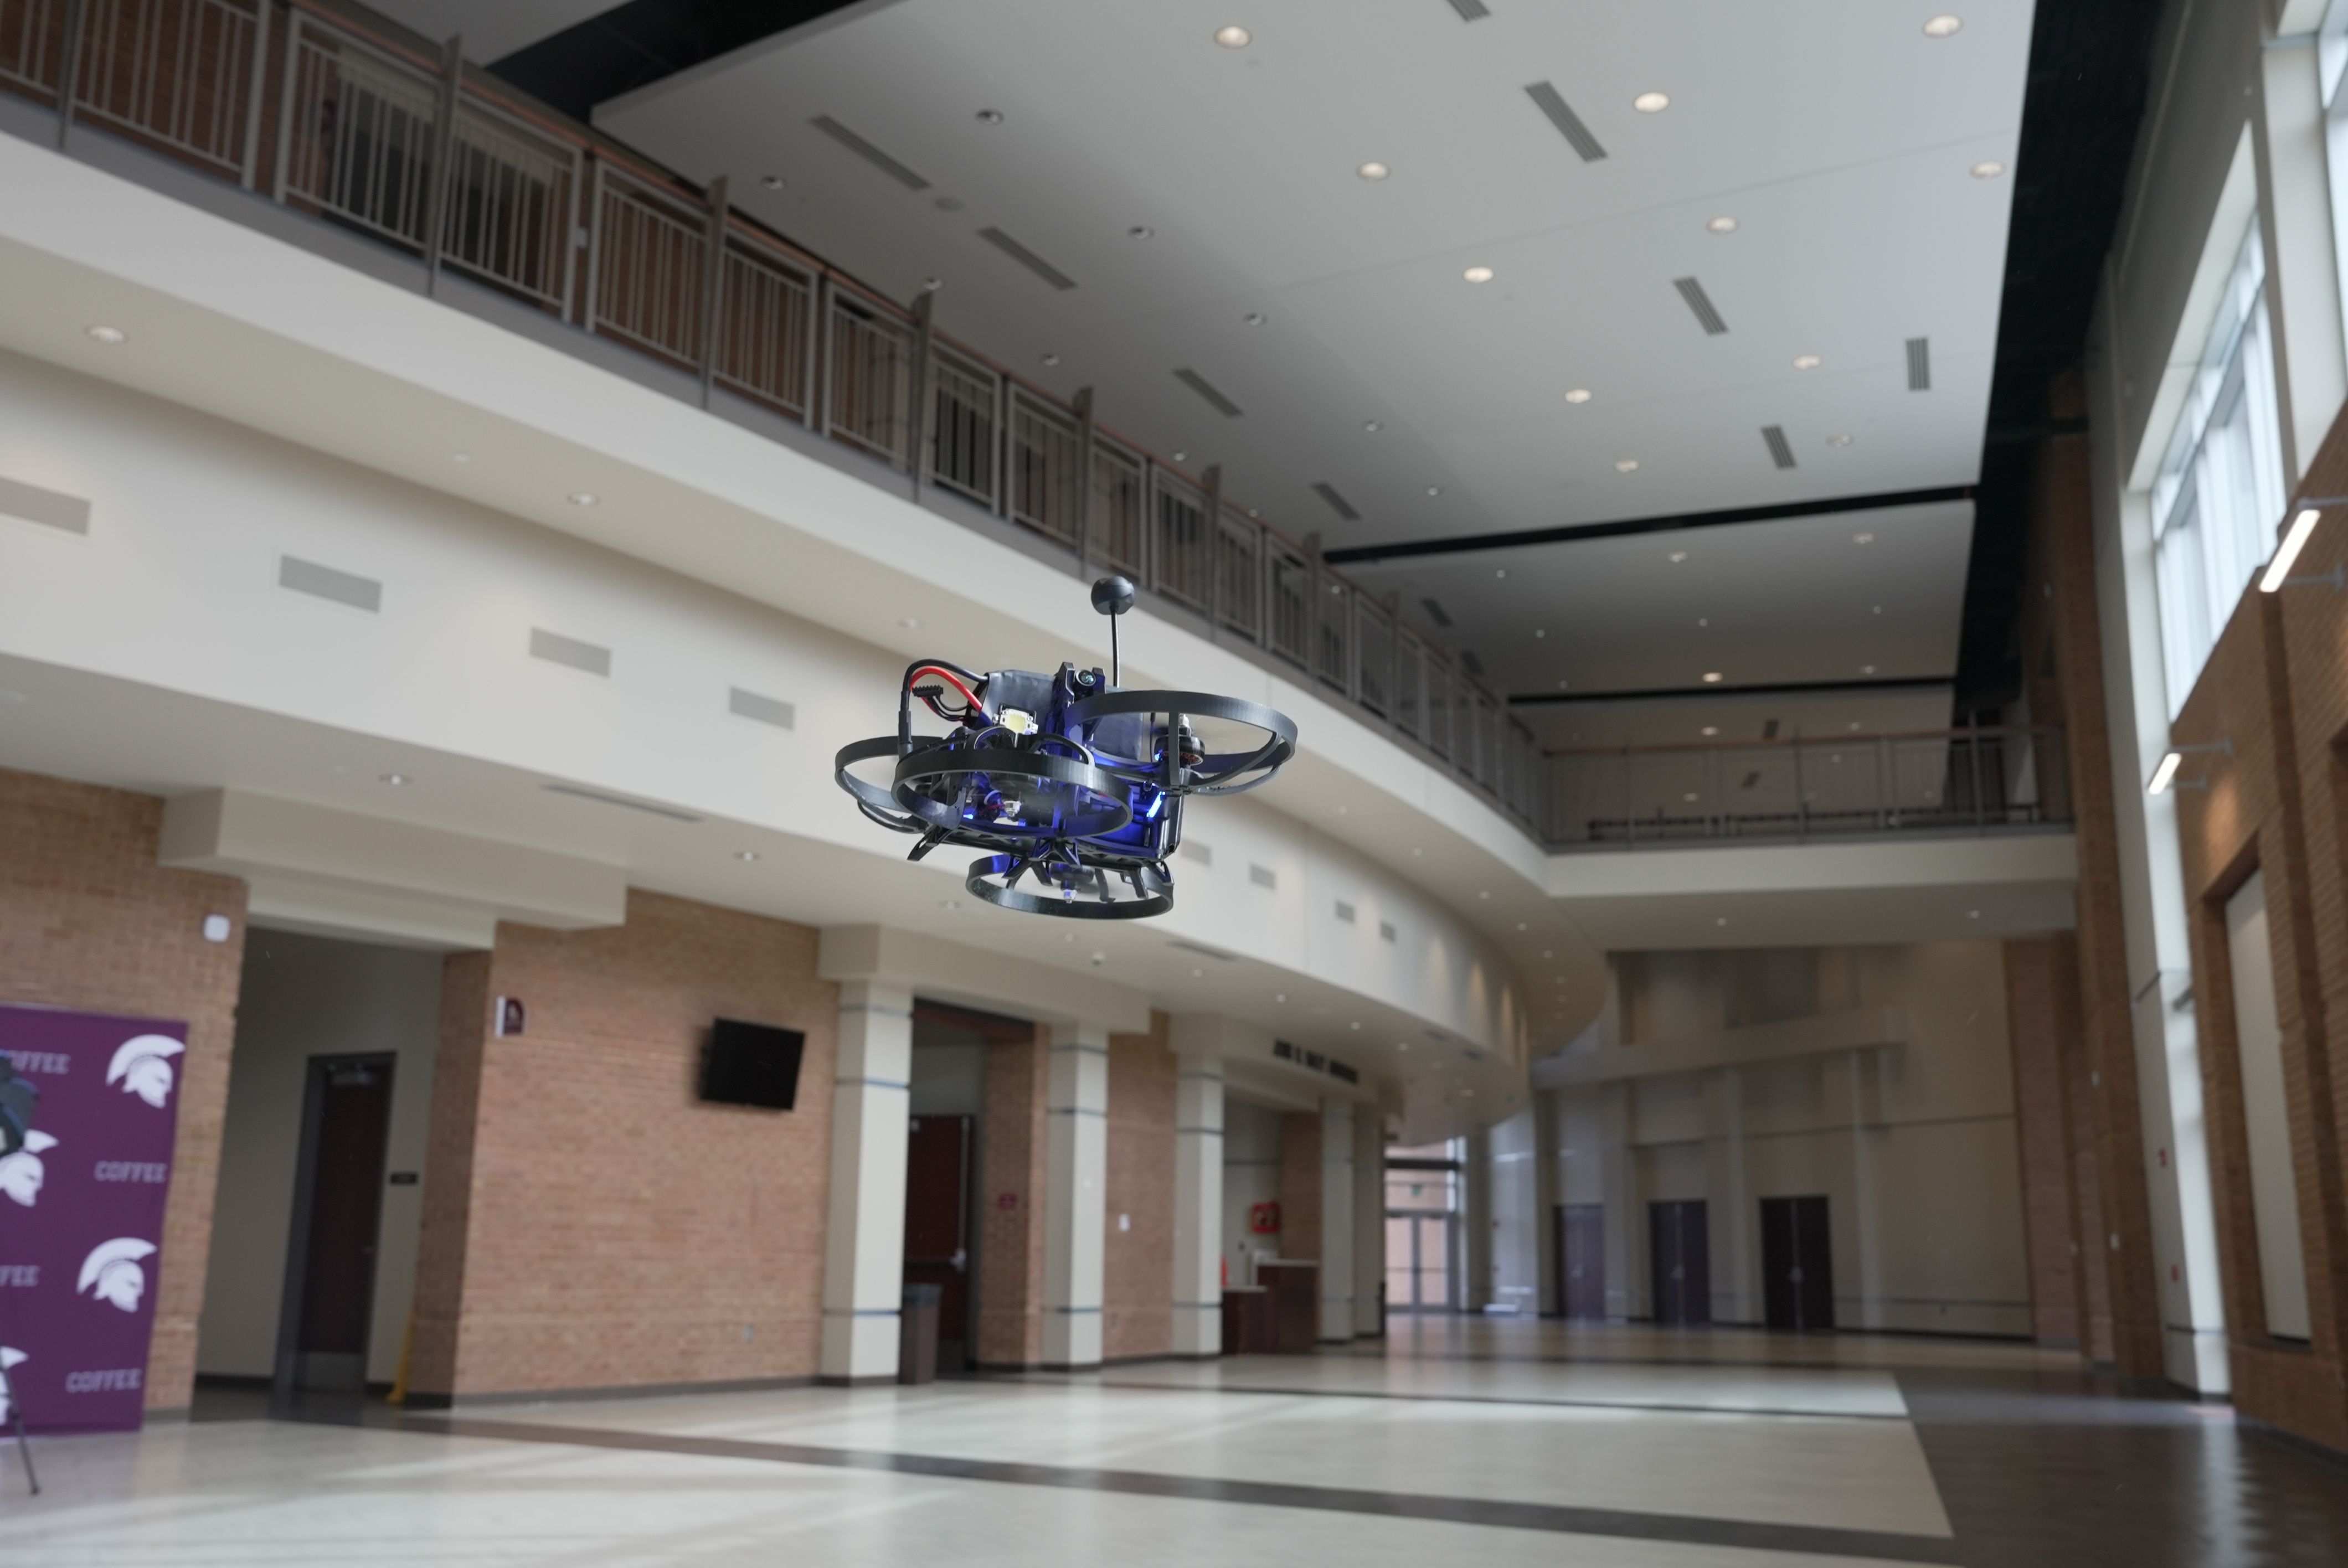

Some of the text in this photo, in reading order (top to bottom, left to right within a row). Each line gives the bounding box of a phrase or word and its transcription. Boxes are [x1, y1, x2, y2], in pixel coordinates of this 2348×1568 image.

[94, 1160, 168, 1183] COFFEE
[0, 1265, 40, 1287] FEE
[66, 1368, 142, 1393] COFFEE
